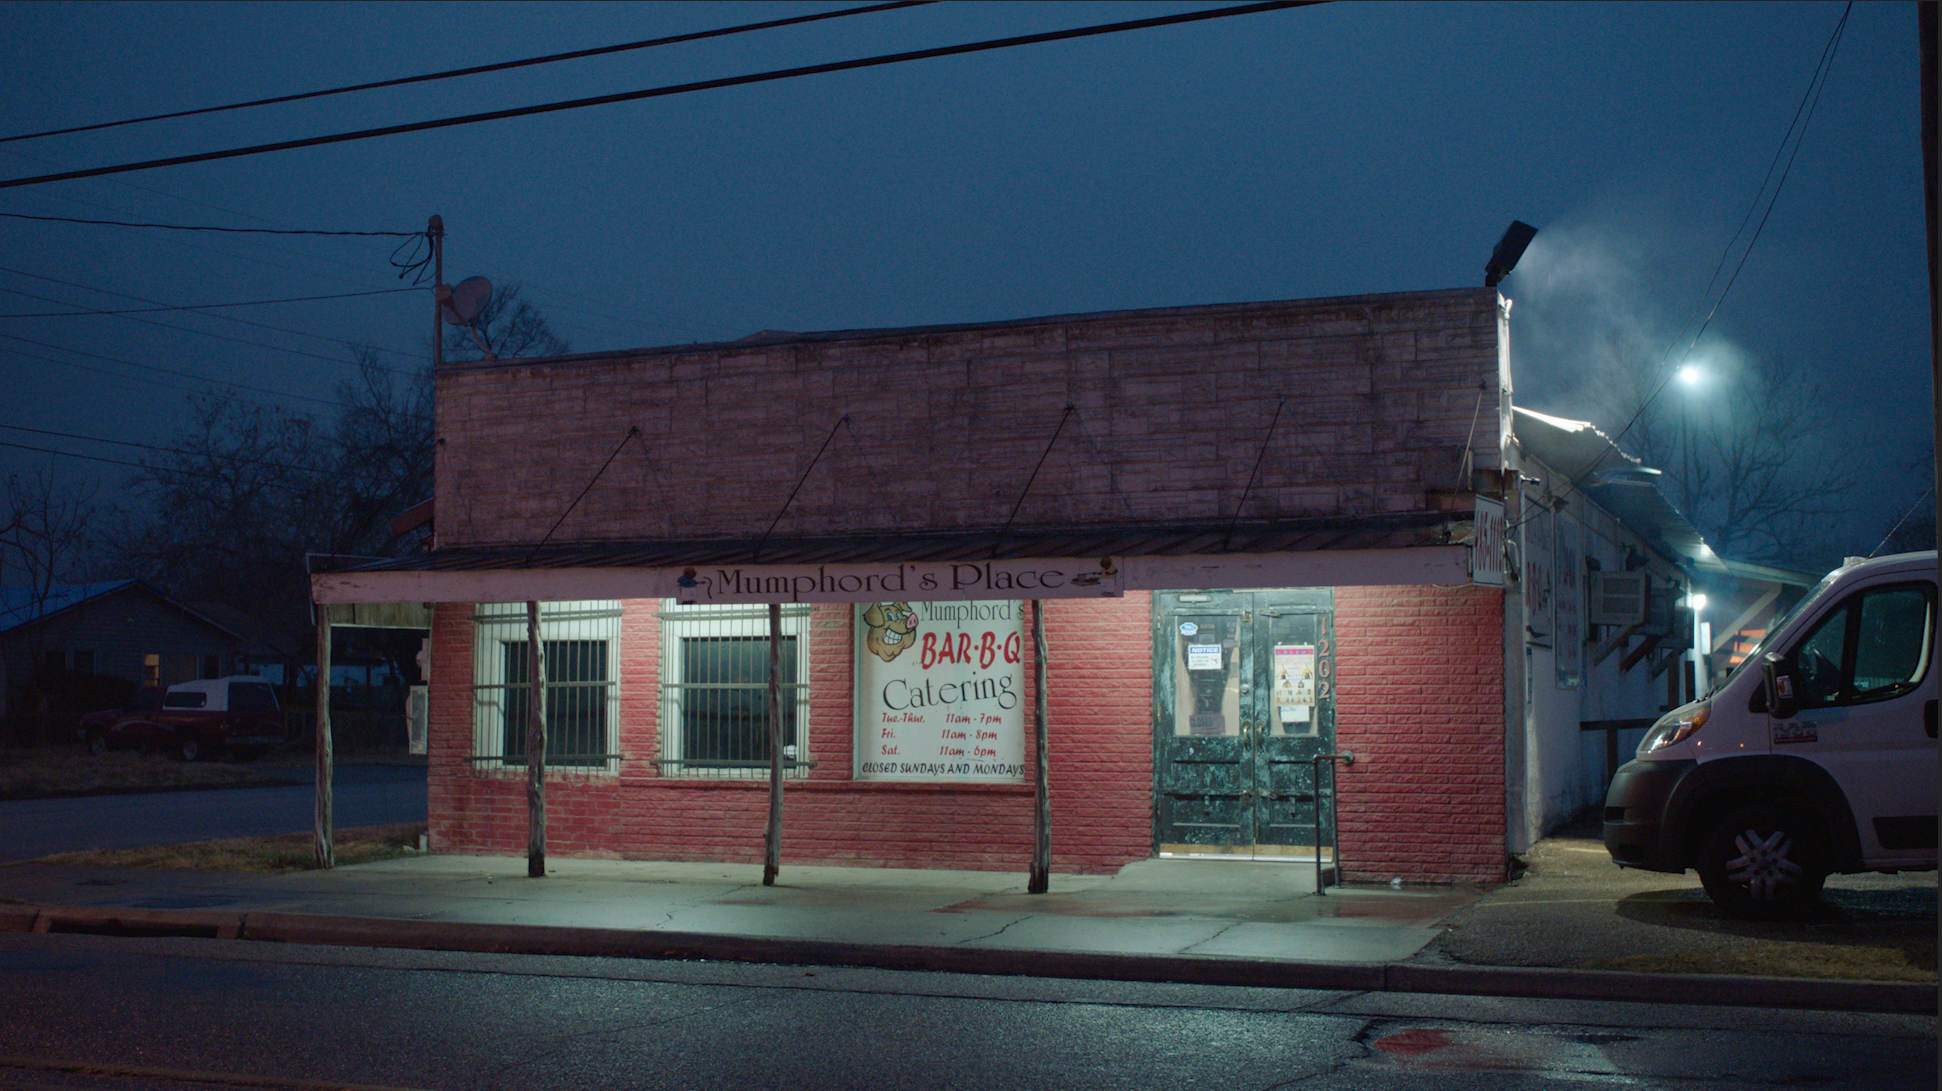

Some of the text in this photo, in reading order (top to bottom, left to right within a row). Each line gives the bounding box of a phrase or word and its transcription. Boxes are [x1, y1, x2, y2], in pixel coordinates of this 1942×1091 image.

[716, 561, 1065, 602] Mumphord's Place
[921, 599, 1024, 629] Mumphord's
[1191, 646, 1219, 654] NOTICE
[1317, 616, 1331, 700] 1202
[882, 671, 1017, 711] Catering
[945, 713, 971, 724] 11am
[980, 713, 1002, 725] 7pm
[881, 728, 896, 739] Fri.
[941, 729, 966, 740] 11am
[975, 729, 998, 740] 8pm
[881, 744, 900, 756] Sat.
[939, 745, 965, 757] 11am
[973, 745, 996, 757] 6pm
[862, 762, 1025, 777] CLOSED SUNDAYS AND MONDAYS
